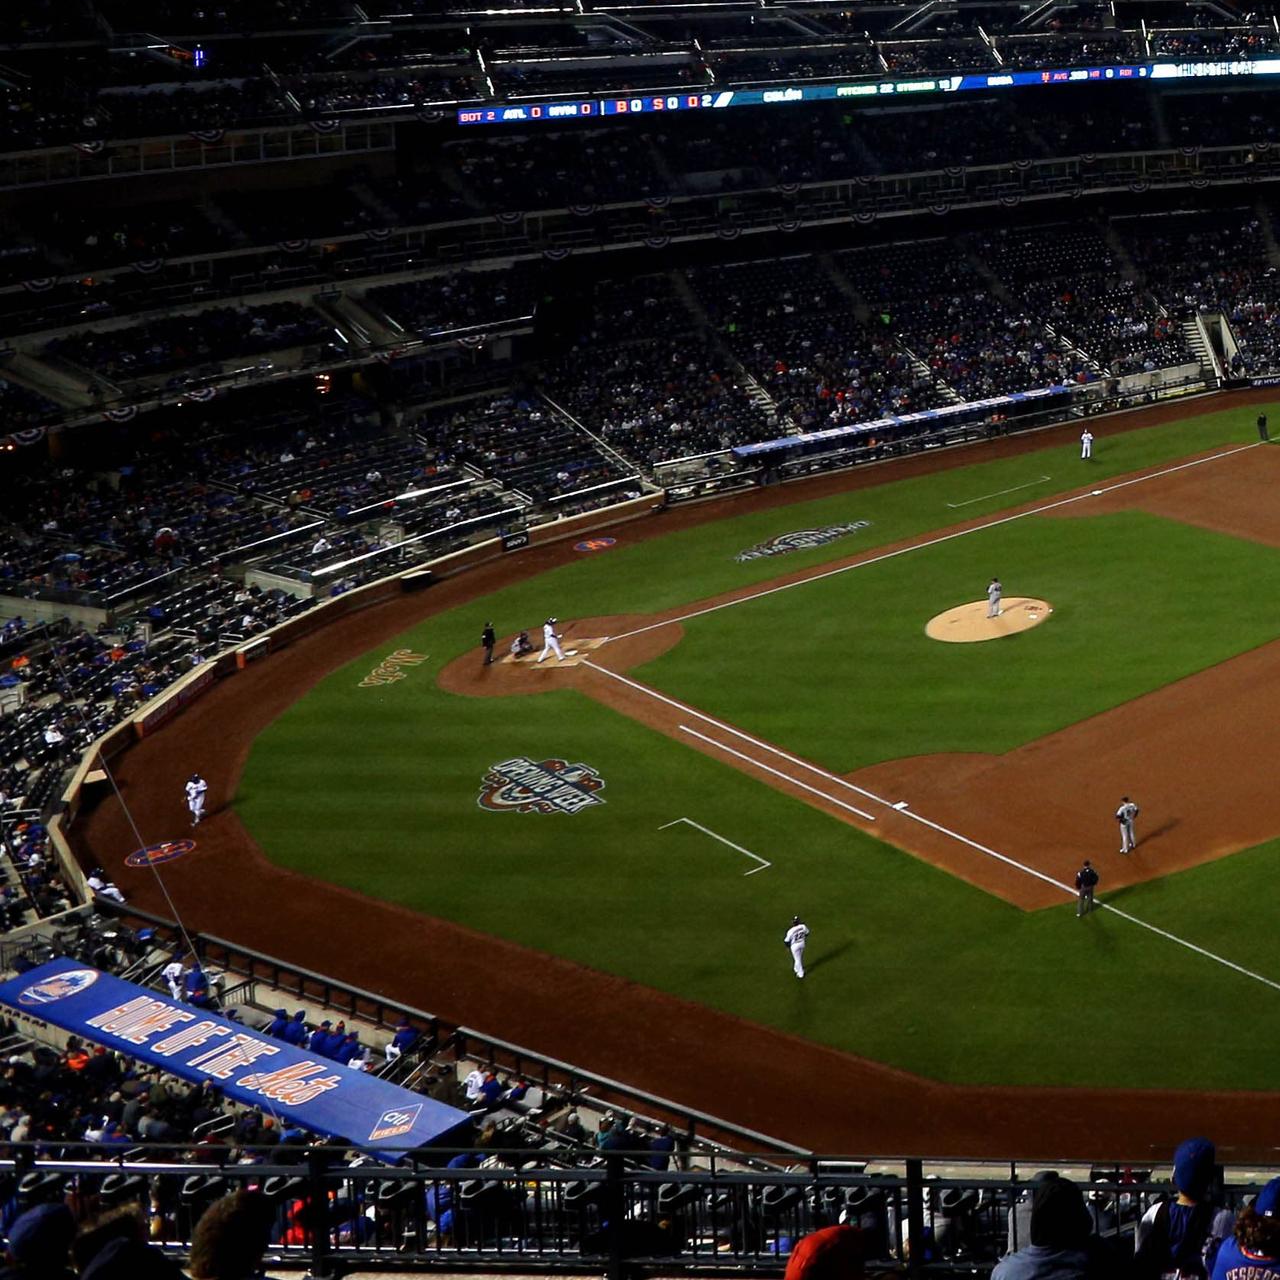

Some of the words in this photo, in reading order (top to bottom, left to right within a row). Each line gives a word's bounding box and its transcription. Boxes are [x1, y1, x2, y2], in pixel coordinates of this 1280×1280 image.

[1053, 72, 1068, 80] AVG
[461, 112, 482, 122] BOT
[487, 111, 495, 120] 2
[503, 108, 527, 119] ATL
[616, 101, 627, 112] B
[653, 98, 663, 109] S
[701, 94, 712, 107] 2
[490, 758, 562, 794] OPENING
[541, 783, 602, 814] WEEK
[85, 995, 196, 1045] HOME
[150, 1021, 232, 1057] OF
[186, 1033, 281, 1080] THE
[236, 1060, 342, 1106] Mets
